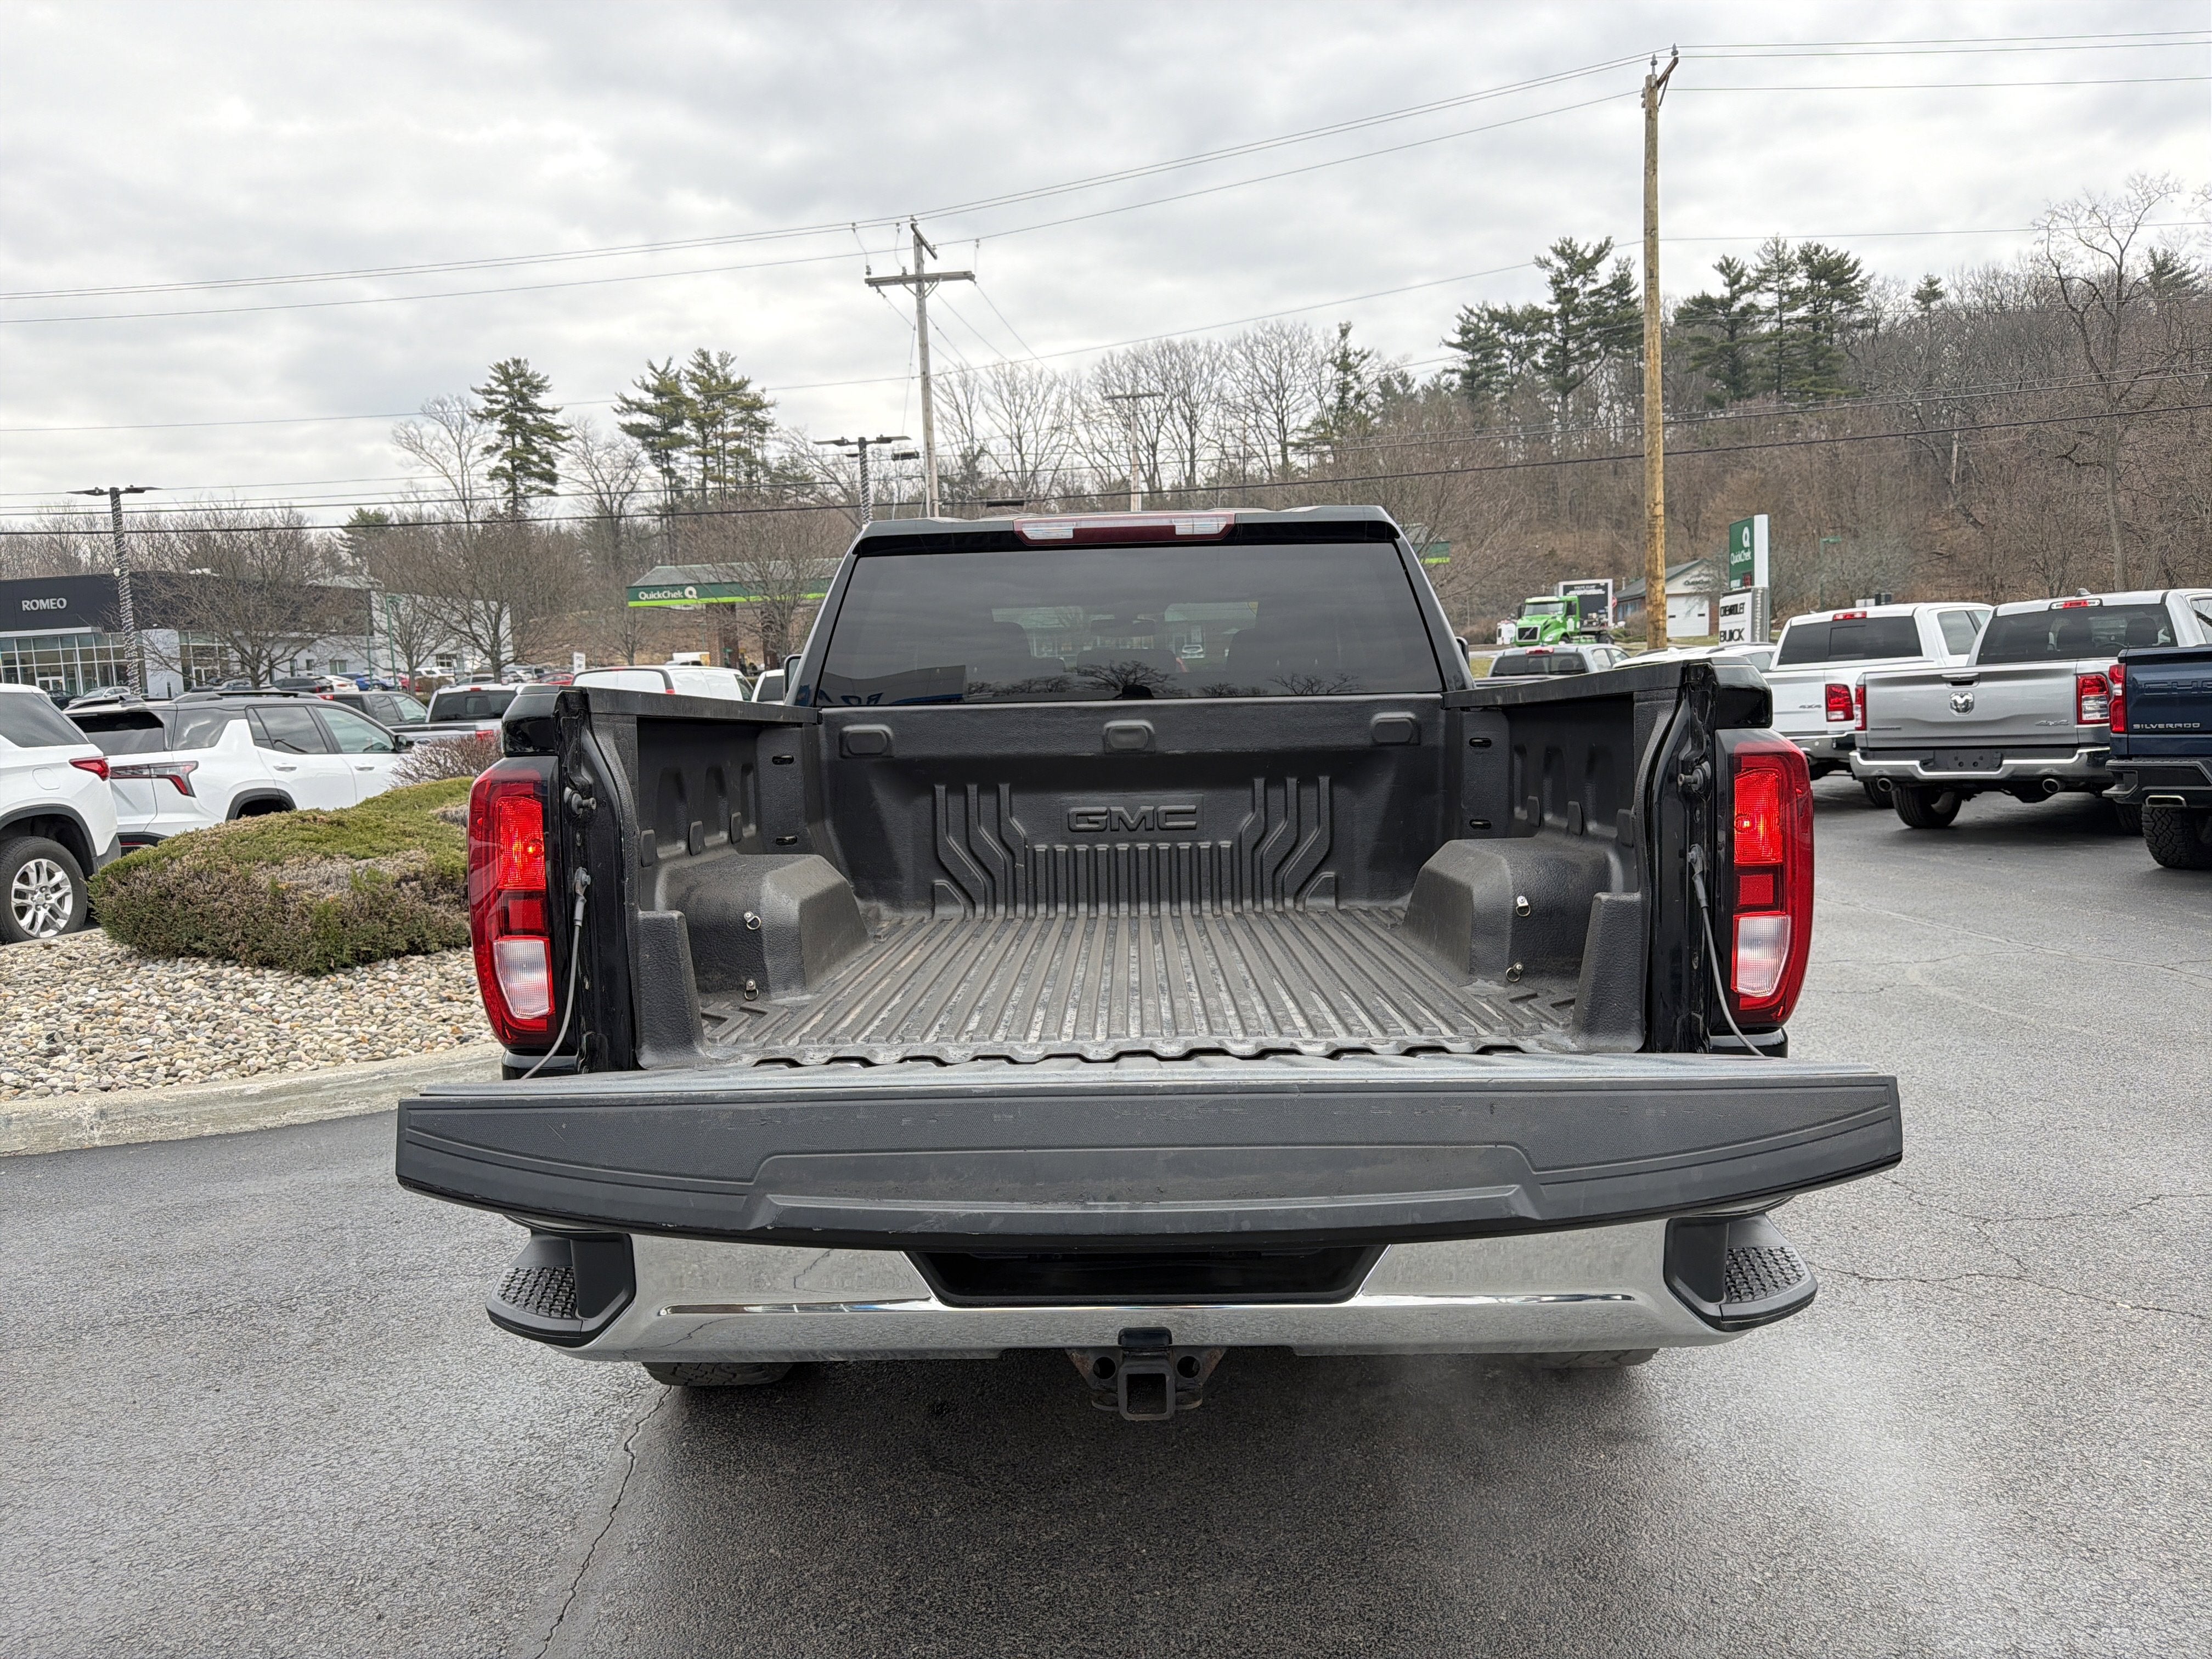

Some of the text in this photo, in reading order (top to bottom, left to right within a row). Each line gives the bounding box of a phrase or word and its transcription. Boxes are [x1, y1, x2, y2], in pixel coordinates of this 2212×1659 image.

[639, 590, 684, 600] QuickChek
[21, 597, 67, 611] ROMEO
[1719, 627, 1745, 642] BUICK
[1068, 805, 1197, 832] GMC
